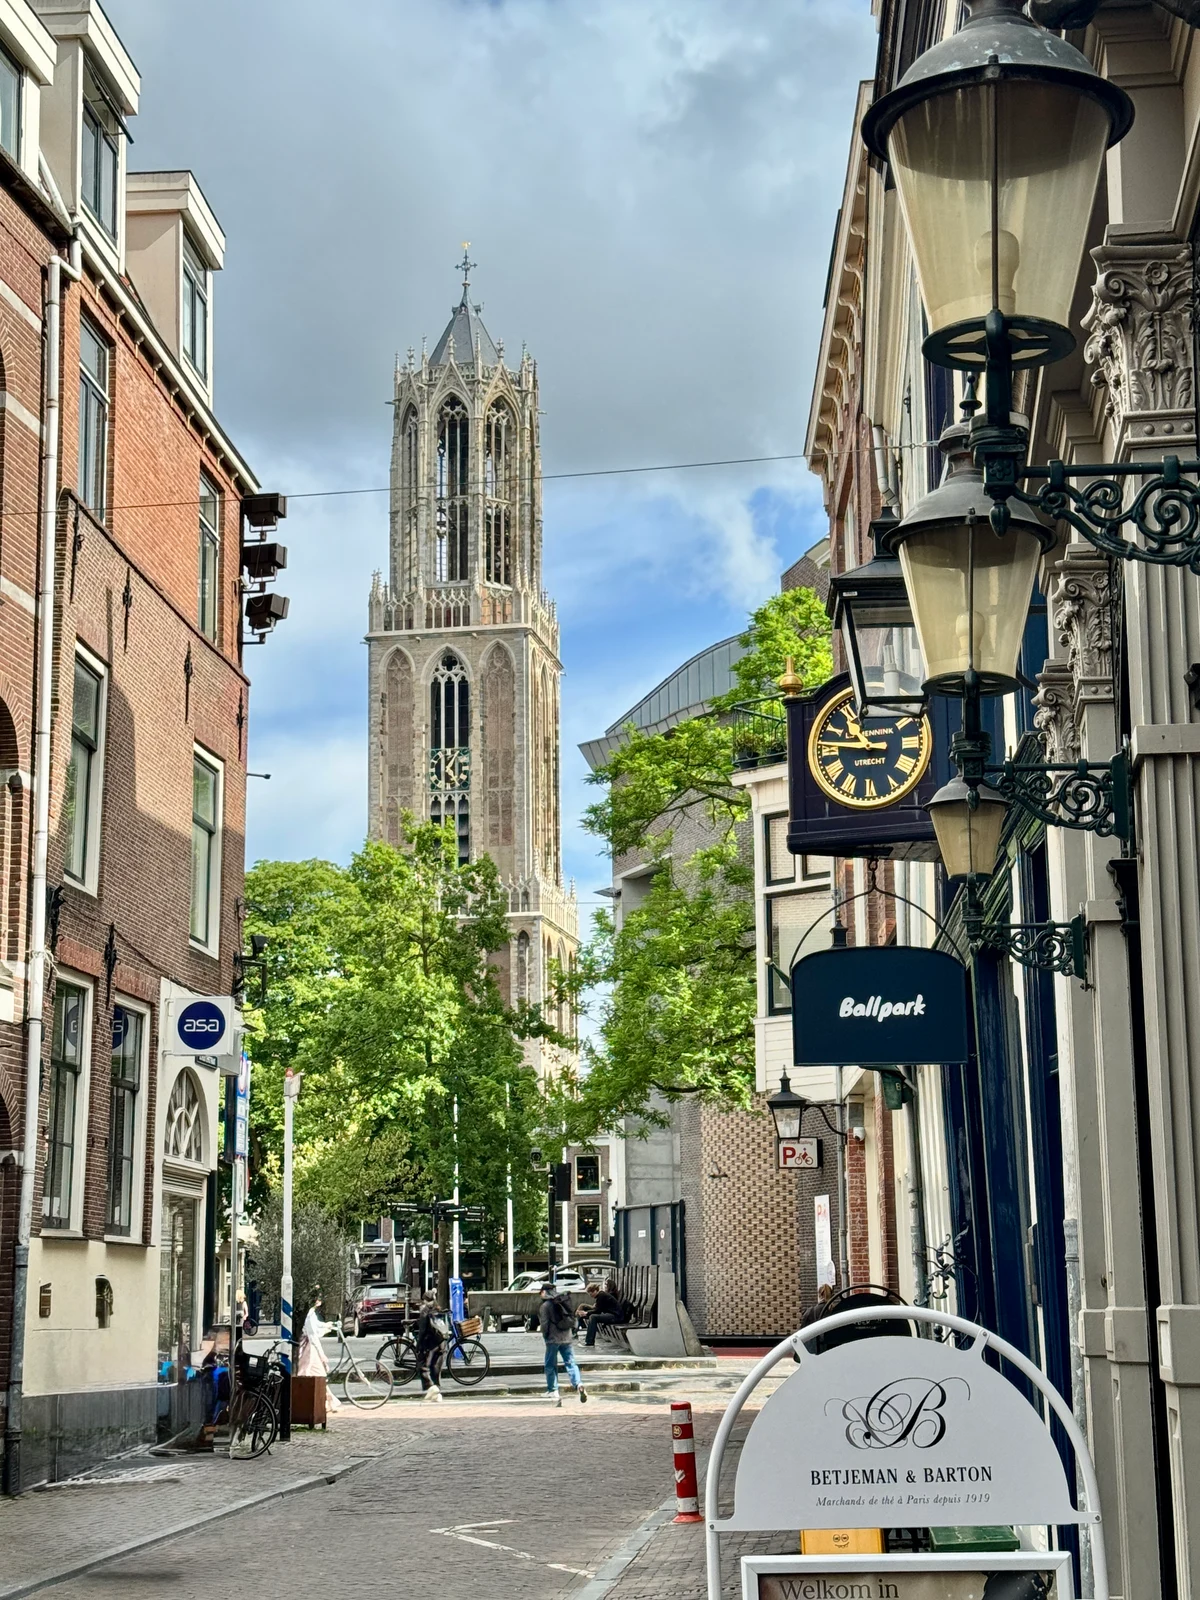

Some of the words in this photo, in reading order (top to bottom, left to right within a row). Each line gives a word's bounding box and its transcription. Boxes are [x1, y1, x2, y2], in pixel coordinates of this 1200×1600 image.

[854, 757, 886, 767] UTRECHT
[839, 994, 926, 1022] Ballpark
[183, 1018, 220, 1032] asa
[782, 1146, 796, 1165] P
[810, 1468, 898, 1486] BETJEMAN
[905, 1469, 917, 1484] &
[923, 1466, 993, 1483] BARTON
[815, 1496, 865, 1507] Marchands
[868, 1496, 878, 1505] de
[881, 1495, 895, 1505] thé
[897, 1494, 903, 1504] à
[906, 1494, 930, 1505] Paris
[933, 1494, 961, 1506] depuis
[965, 1493, 990, 1503] 1919
[778, 1580, 873, 1600] Welkom
[878, 1578, 900, 1599] in
